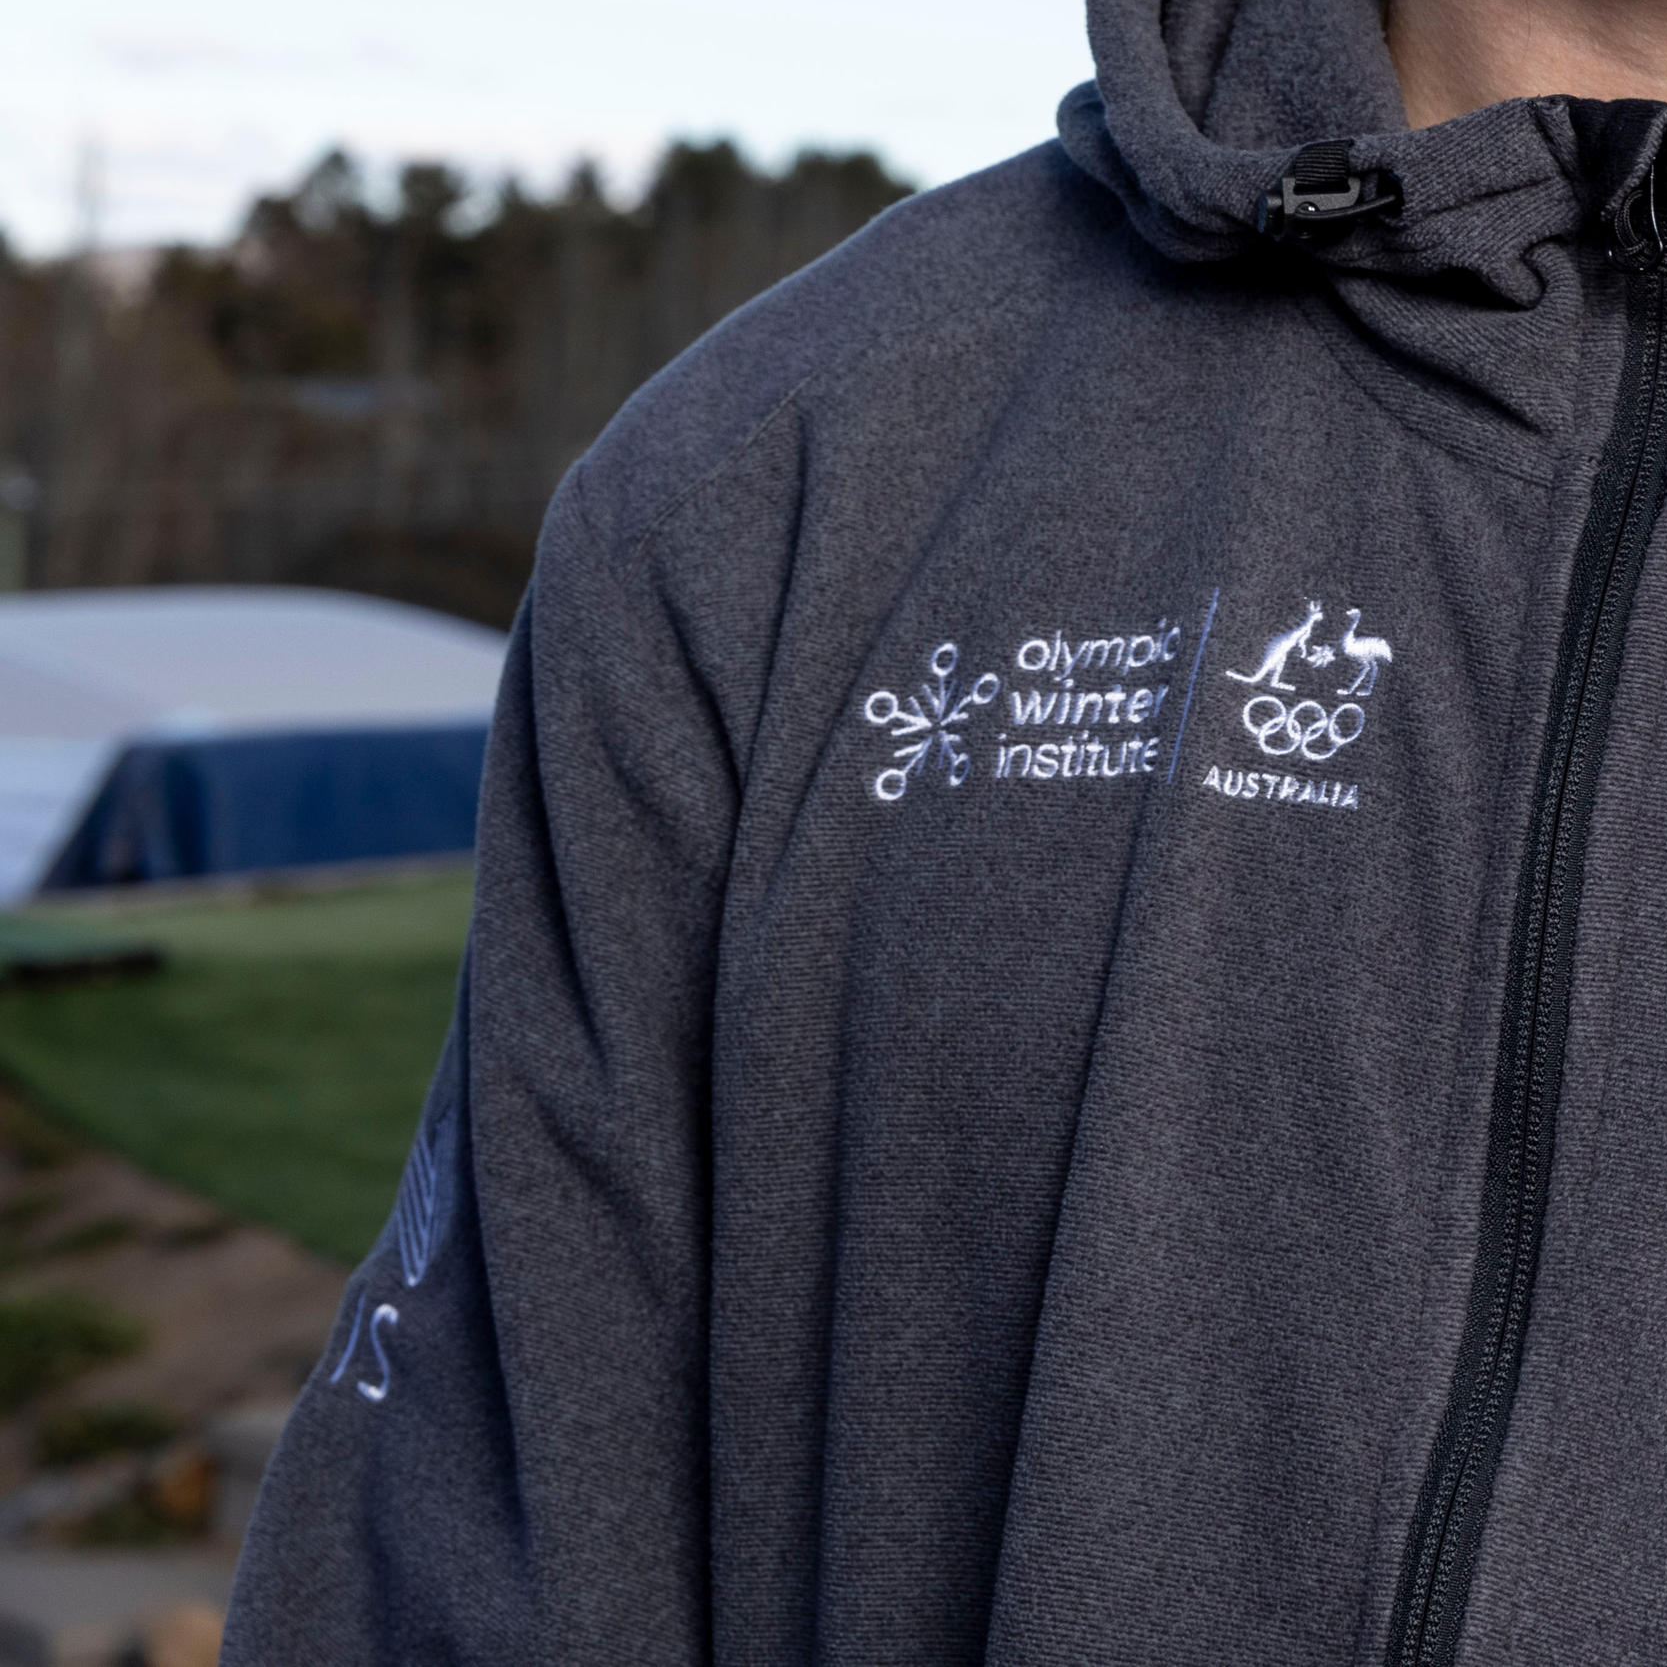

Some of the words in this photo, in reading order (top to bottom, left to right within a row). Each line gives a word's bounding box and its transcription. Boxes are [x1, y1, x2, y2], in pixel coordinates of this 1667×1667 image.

[1018, 617, 1181, 681] olympic
[1011, 678, 1169, 725] winter
[996, 730, 1160, 779] institute
[1202, 765, 1358, 810] AUSTRALIA
